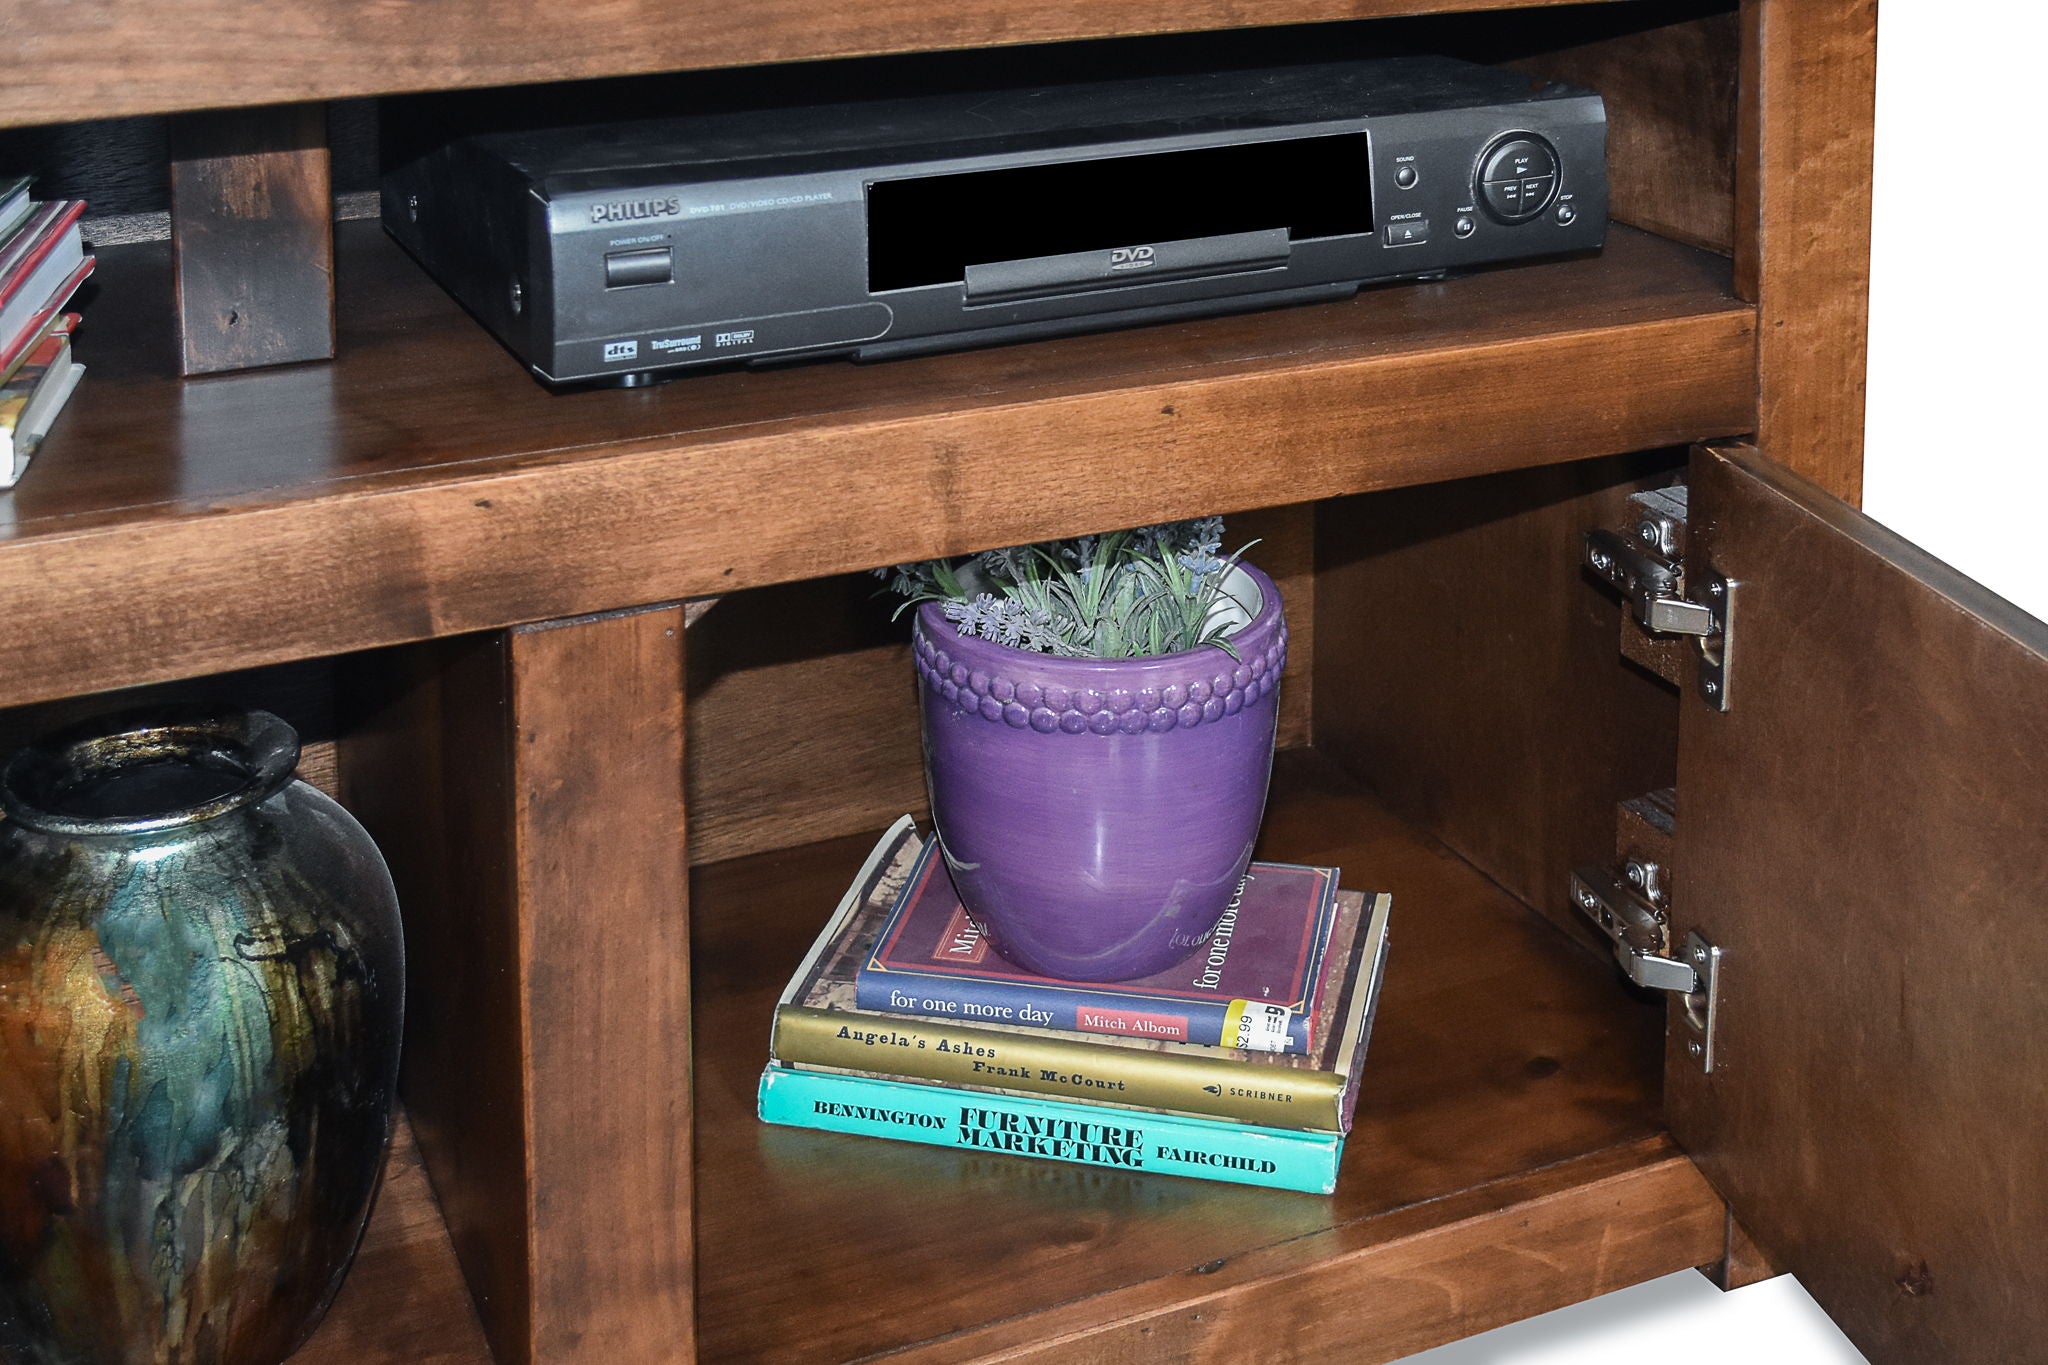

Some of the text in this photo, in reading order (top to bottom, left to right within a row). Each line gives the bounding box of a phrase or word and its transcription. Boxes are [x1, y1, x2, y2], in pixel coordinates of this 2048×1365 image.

[1396, 155, 1415, 163] SOUND
[804, 192, 834, 203] PLAYER
[1456, 205, 1474, 213] PAUSE
[591, 198, 681, 224] PHILIPS
[1390, 212, 1423, 221] OPEN/CLOSE
[609, 236, 637, 247] POWER
[1111, 246, 1155, 263] DVD
[607, 344, 635, 357] dts
[1192, 966, 1221, 990] for
[1207, 938, 1230, 966] one
[890, 989, 1055, 1026] for one more day
[1084, 1014, 1181, 1035] Mitch Albom
[1235, 1015, 1253, 1049] $2.99
[836, 1025, 996, 1058] Angela's Ashes
[972, 1060, 1126, 1092] Frank McCourt
[1229, 1087, 1293, 1103] SCRIBNER
[812, 1100, 947, 1130] BENNINGTON
[958, 1106, 1144, 1150] FURNITURE
[956, 1126, 1144, 1167] MARKETING
[1156, 1146, 1277, 1174] FAIRCHILD
